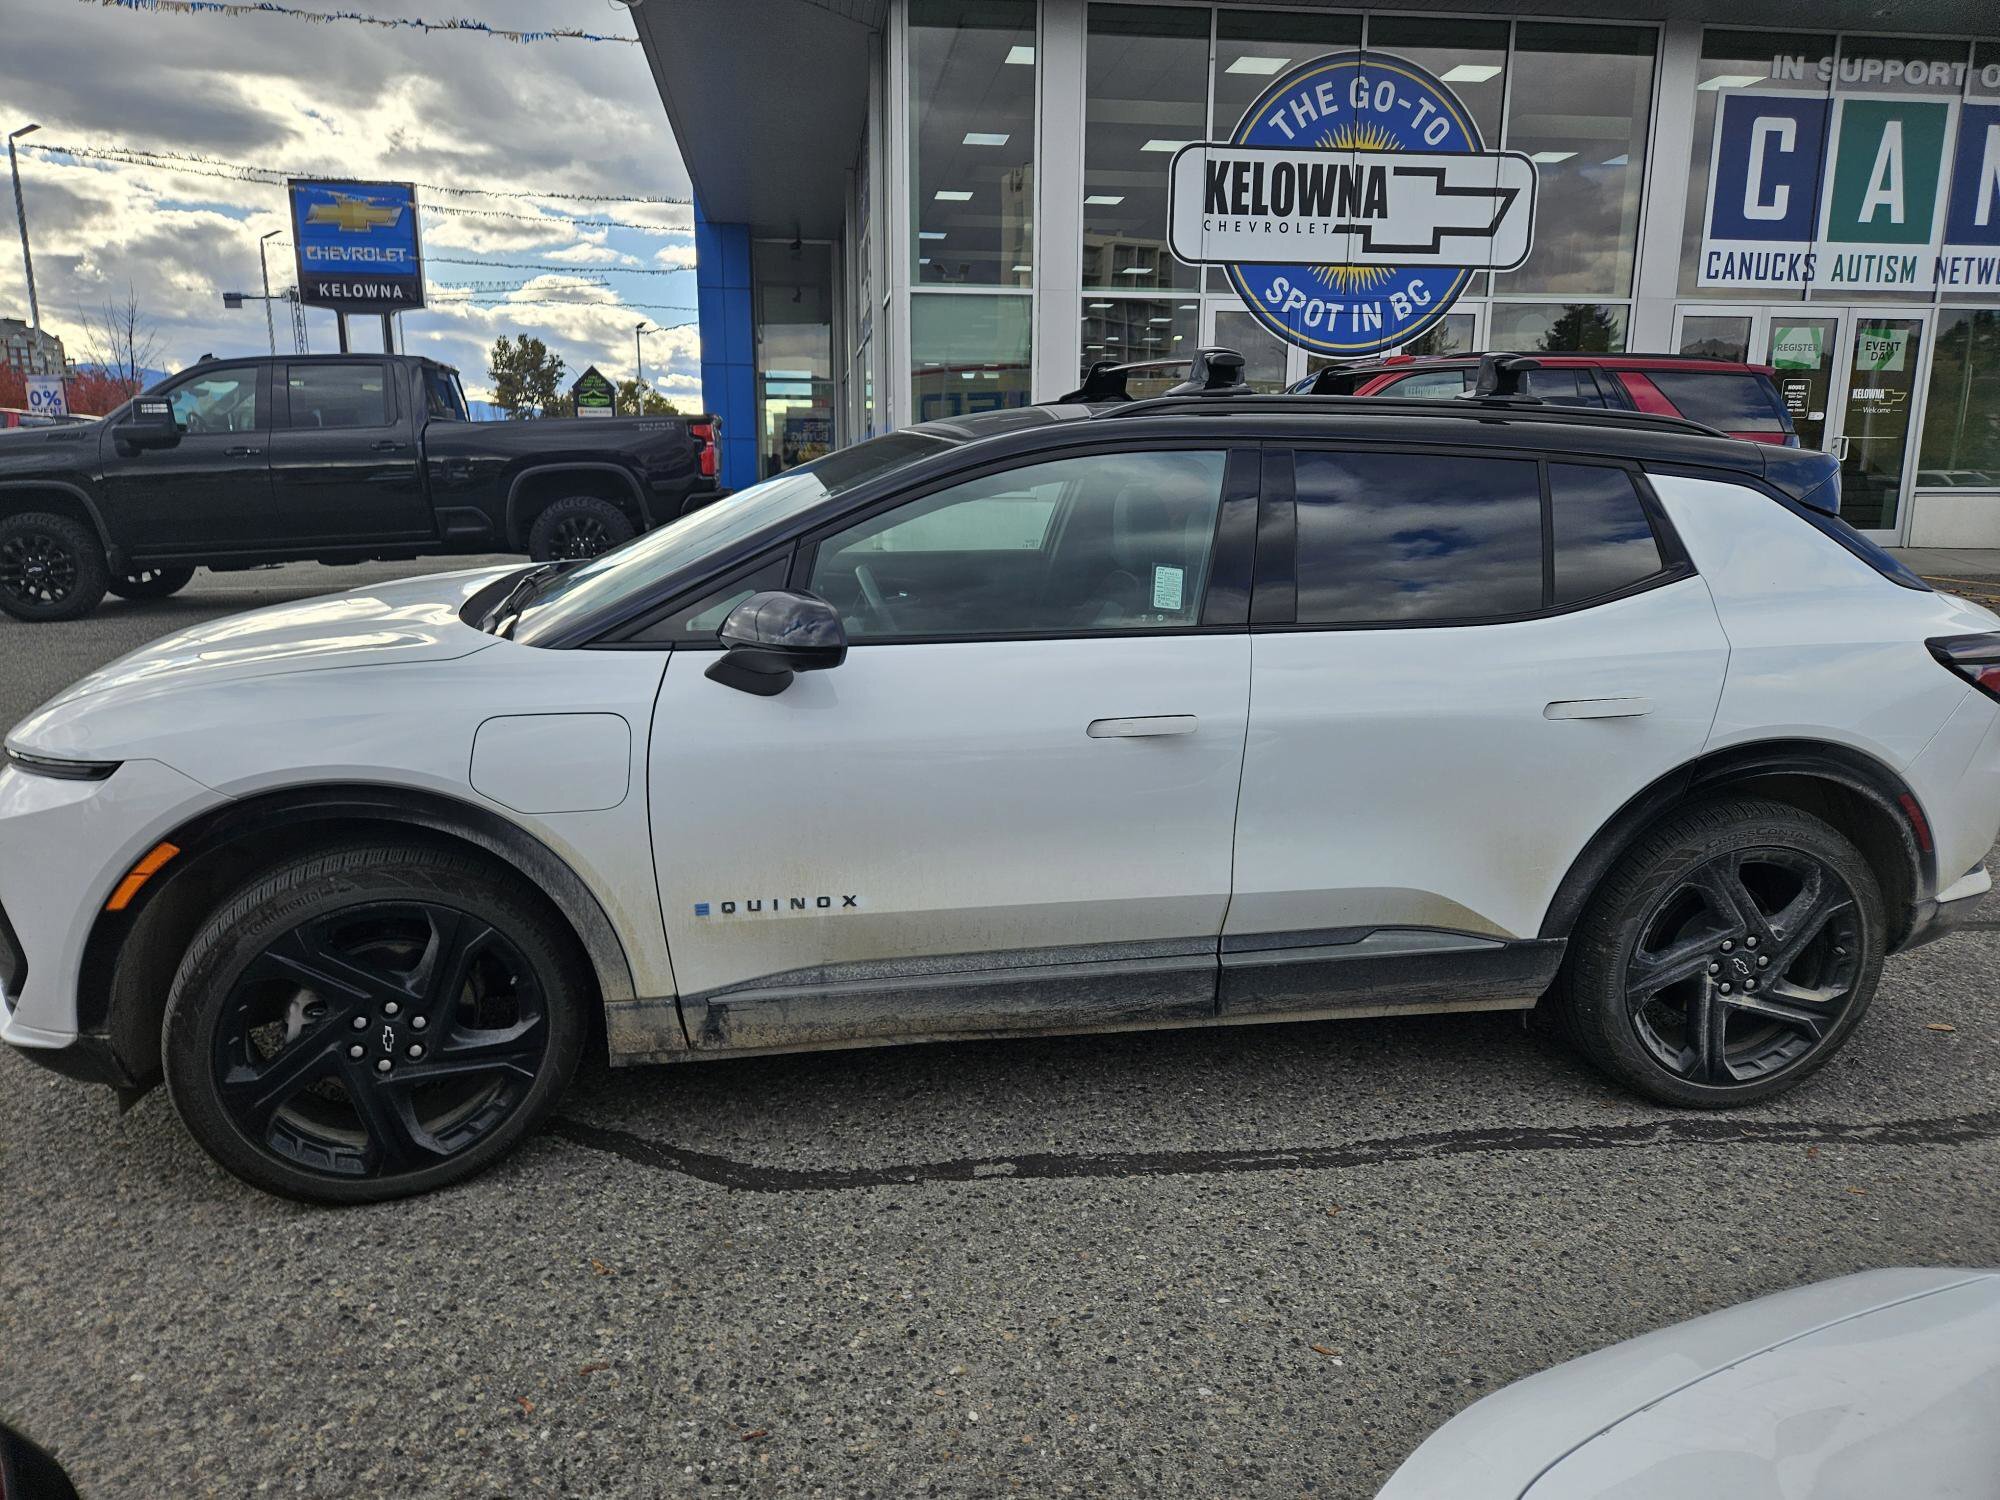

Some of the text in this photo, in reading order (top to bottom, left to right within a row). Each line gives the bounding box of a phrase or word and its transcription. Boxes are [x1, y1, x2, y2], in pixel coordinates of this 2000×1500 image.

[1771, 55, 1805, 80] IN
[1816, 56, 1968, 86] SUPPORT
[1268, 75, 1450, 146] THE GO-TO
[1204, 159, 1389, 219] KELOWNA
[1203, 219, 1329, 235] CHEVROLET
[306, 245, 407, 262] CHEVROLET
[1706, 250, 1817, 282] CANUCKS
[1830, 254, 1918, 283] AUTISM
[319, 283, 403, 298] KELOWNA
[1265, 275, 1432, 333] SPOT IN BC
[1865, 341, 1902, 351] EVENT
[1871, 351, 1895, 361] DAY
[30, 390, 62, 406] 0%
[1852, 388, 1885, 399] KELOWNA
[1863, 406, 1891, 414] Welcome
